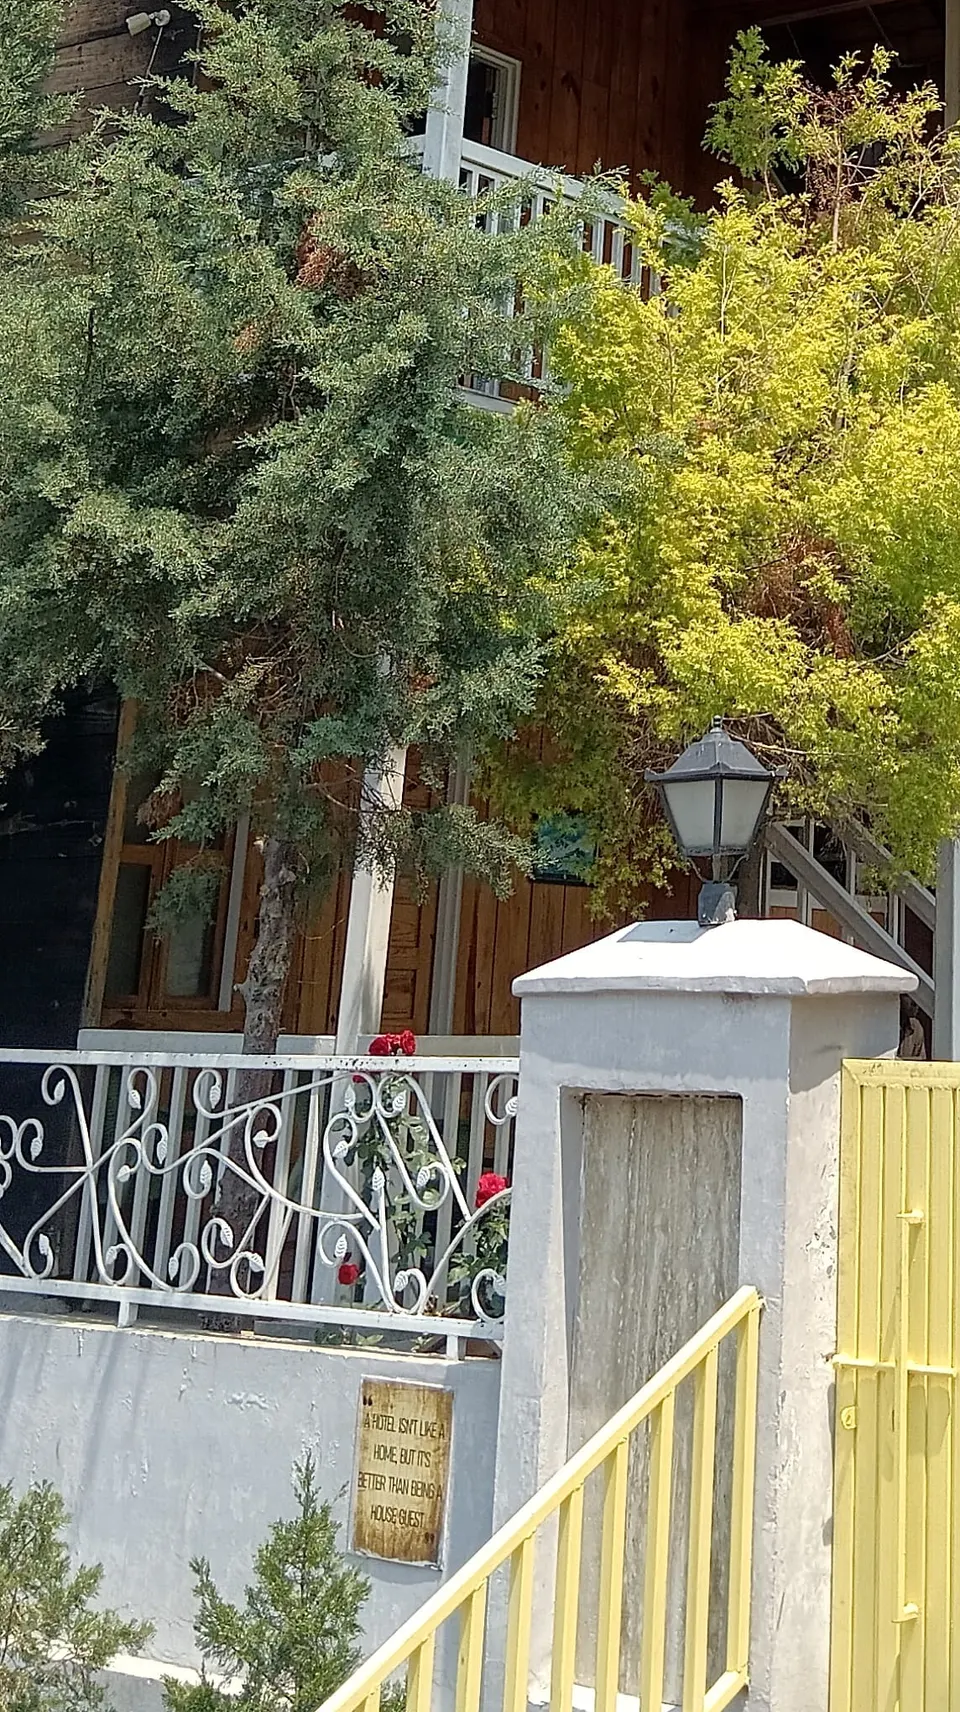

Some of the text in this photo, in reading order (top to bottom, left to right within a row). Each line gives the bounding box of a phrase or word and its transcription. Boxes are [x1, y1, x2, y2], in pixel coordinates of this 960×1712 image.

[363, 1413, 370, 1428] A
[372, 1414, 396, 1432] HOTEL
[419, 1418, 437, 1438] LIKE
[438, 1422, 445, 1439] A
[399, 1448, 416, 1465] BUT
[357, 1471, 443, 1501] BETTER THAN BEING A
[370, 1504, 424, 1528] HOUSE GUEST
